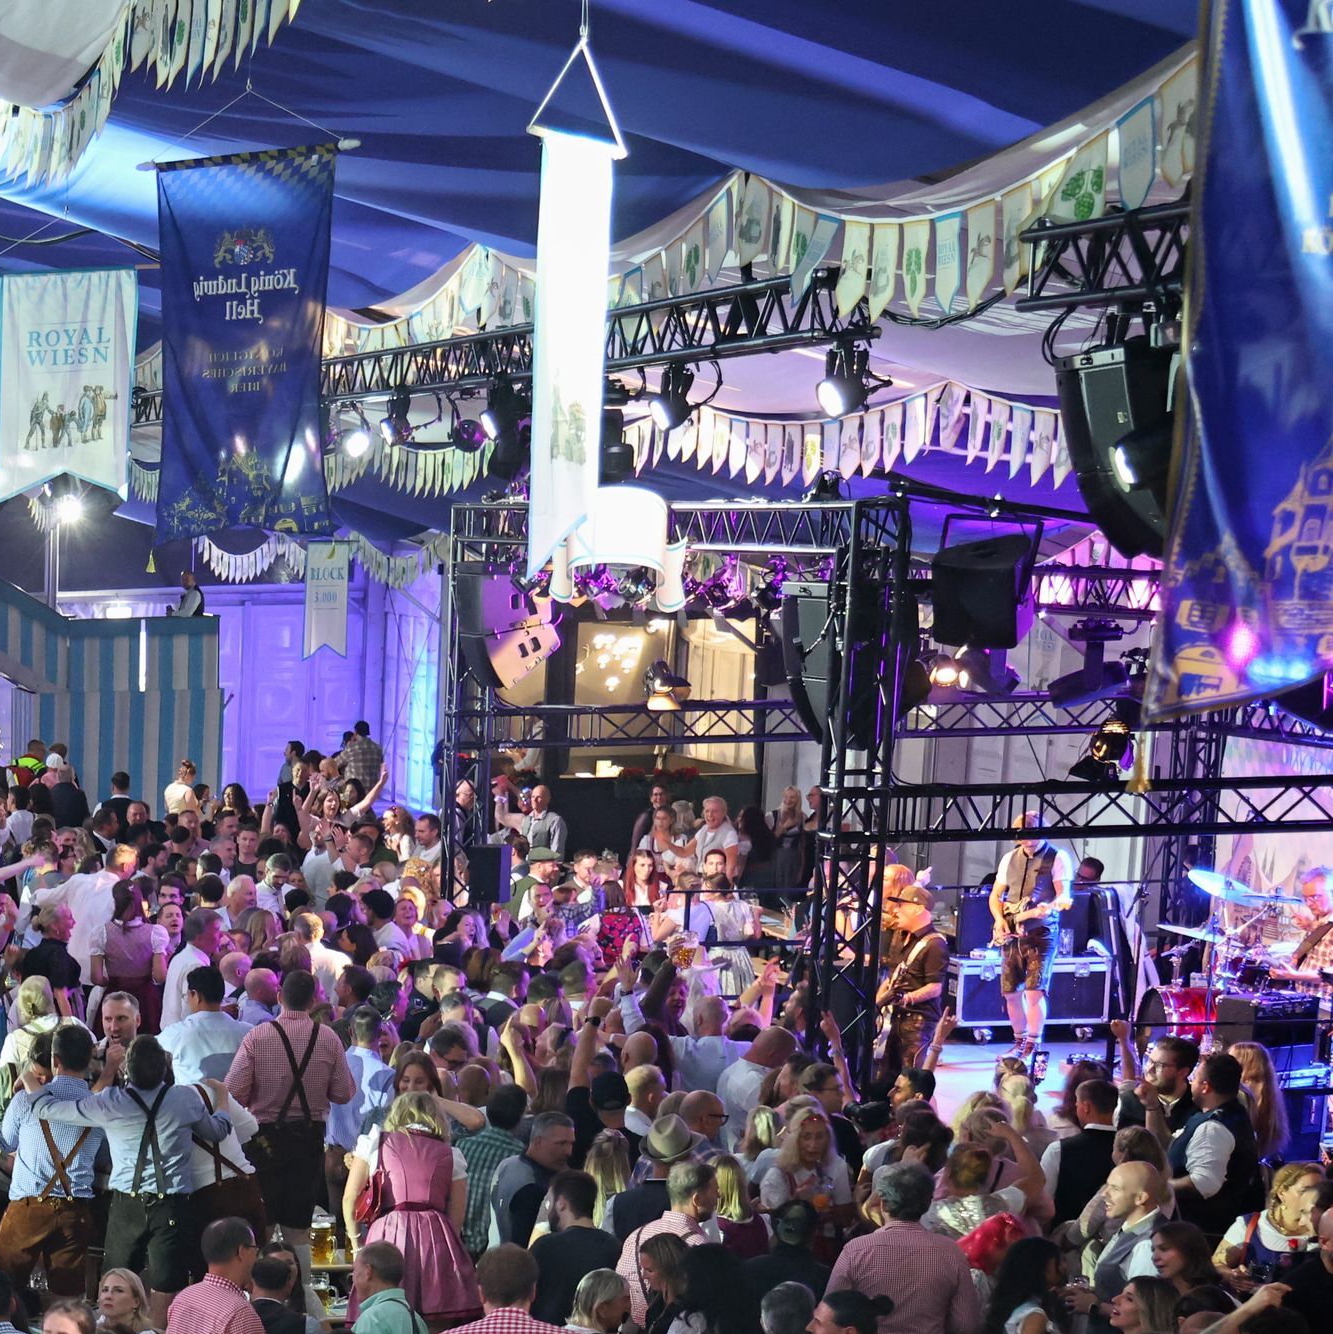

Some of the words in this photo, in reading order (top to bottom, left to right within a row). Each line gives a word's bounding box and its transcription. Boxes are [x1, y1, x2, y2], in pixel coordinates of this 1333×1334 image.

[27, 327, 111, 347] ROYAL
[27, 346, 110, 367] WIESN
[310, 567, 344, 580] BLOCK
